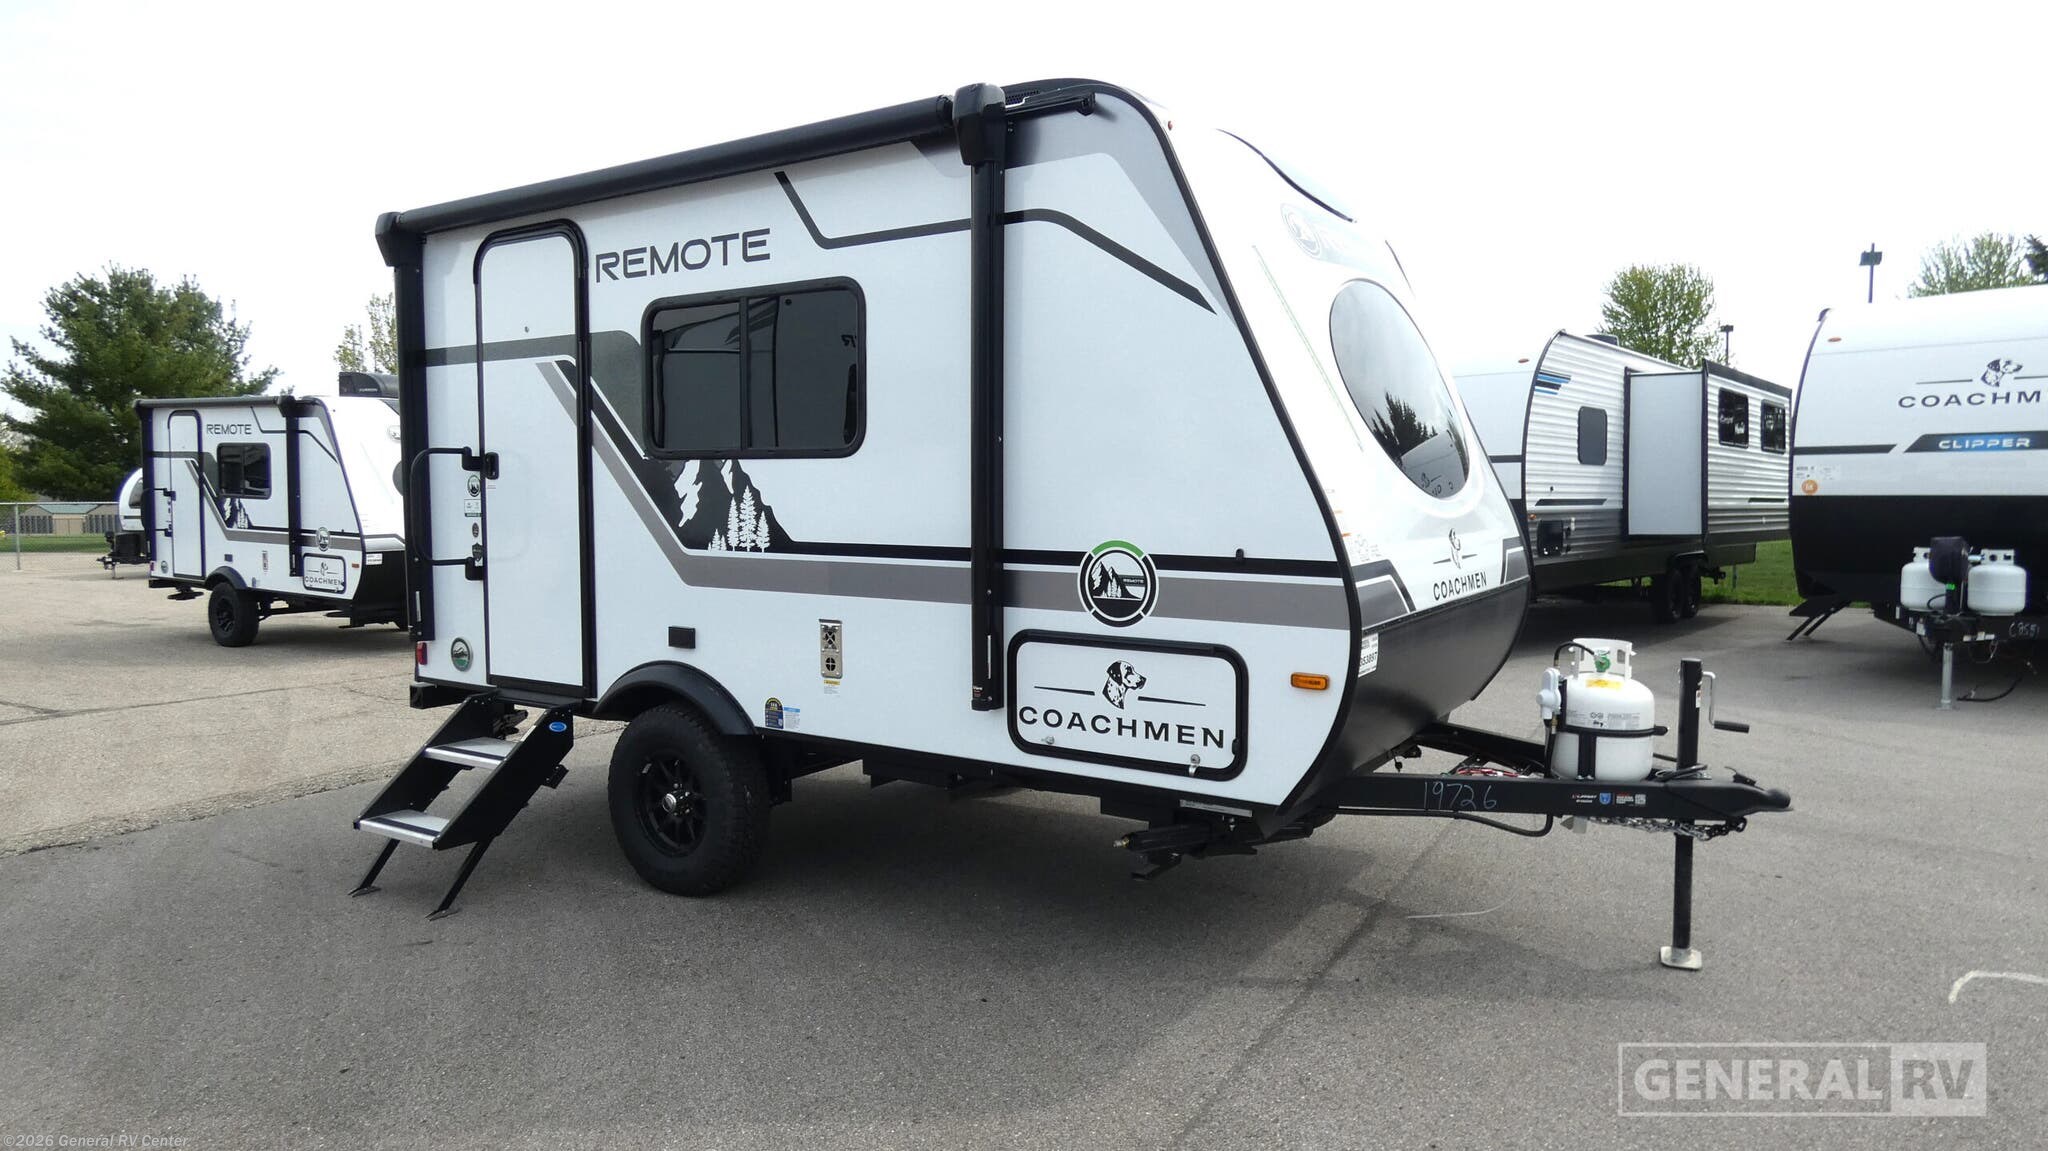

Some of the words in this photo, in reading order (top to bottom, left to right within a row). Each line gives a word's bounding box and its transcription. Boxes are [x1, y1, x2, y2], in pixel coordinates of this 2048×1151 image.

[596, 228, 771, 283] REMOTE
[1898, 390, 2041, 409] COACHM
[206, 424, 252, 435] REMOTE
[1938, 438, 2031, 450] CLIPPER
[1433, 571, 1487, 601] COACHMEN
[1019, 706, 1224, 749] COACHMEN
[1424, 781, 1497, 809] 19726
